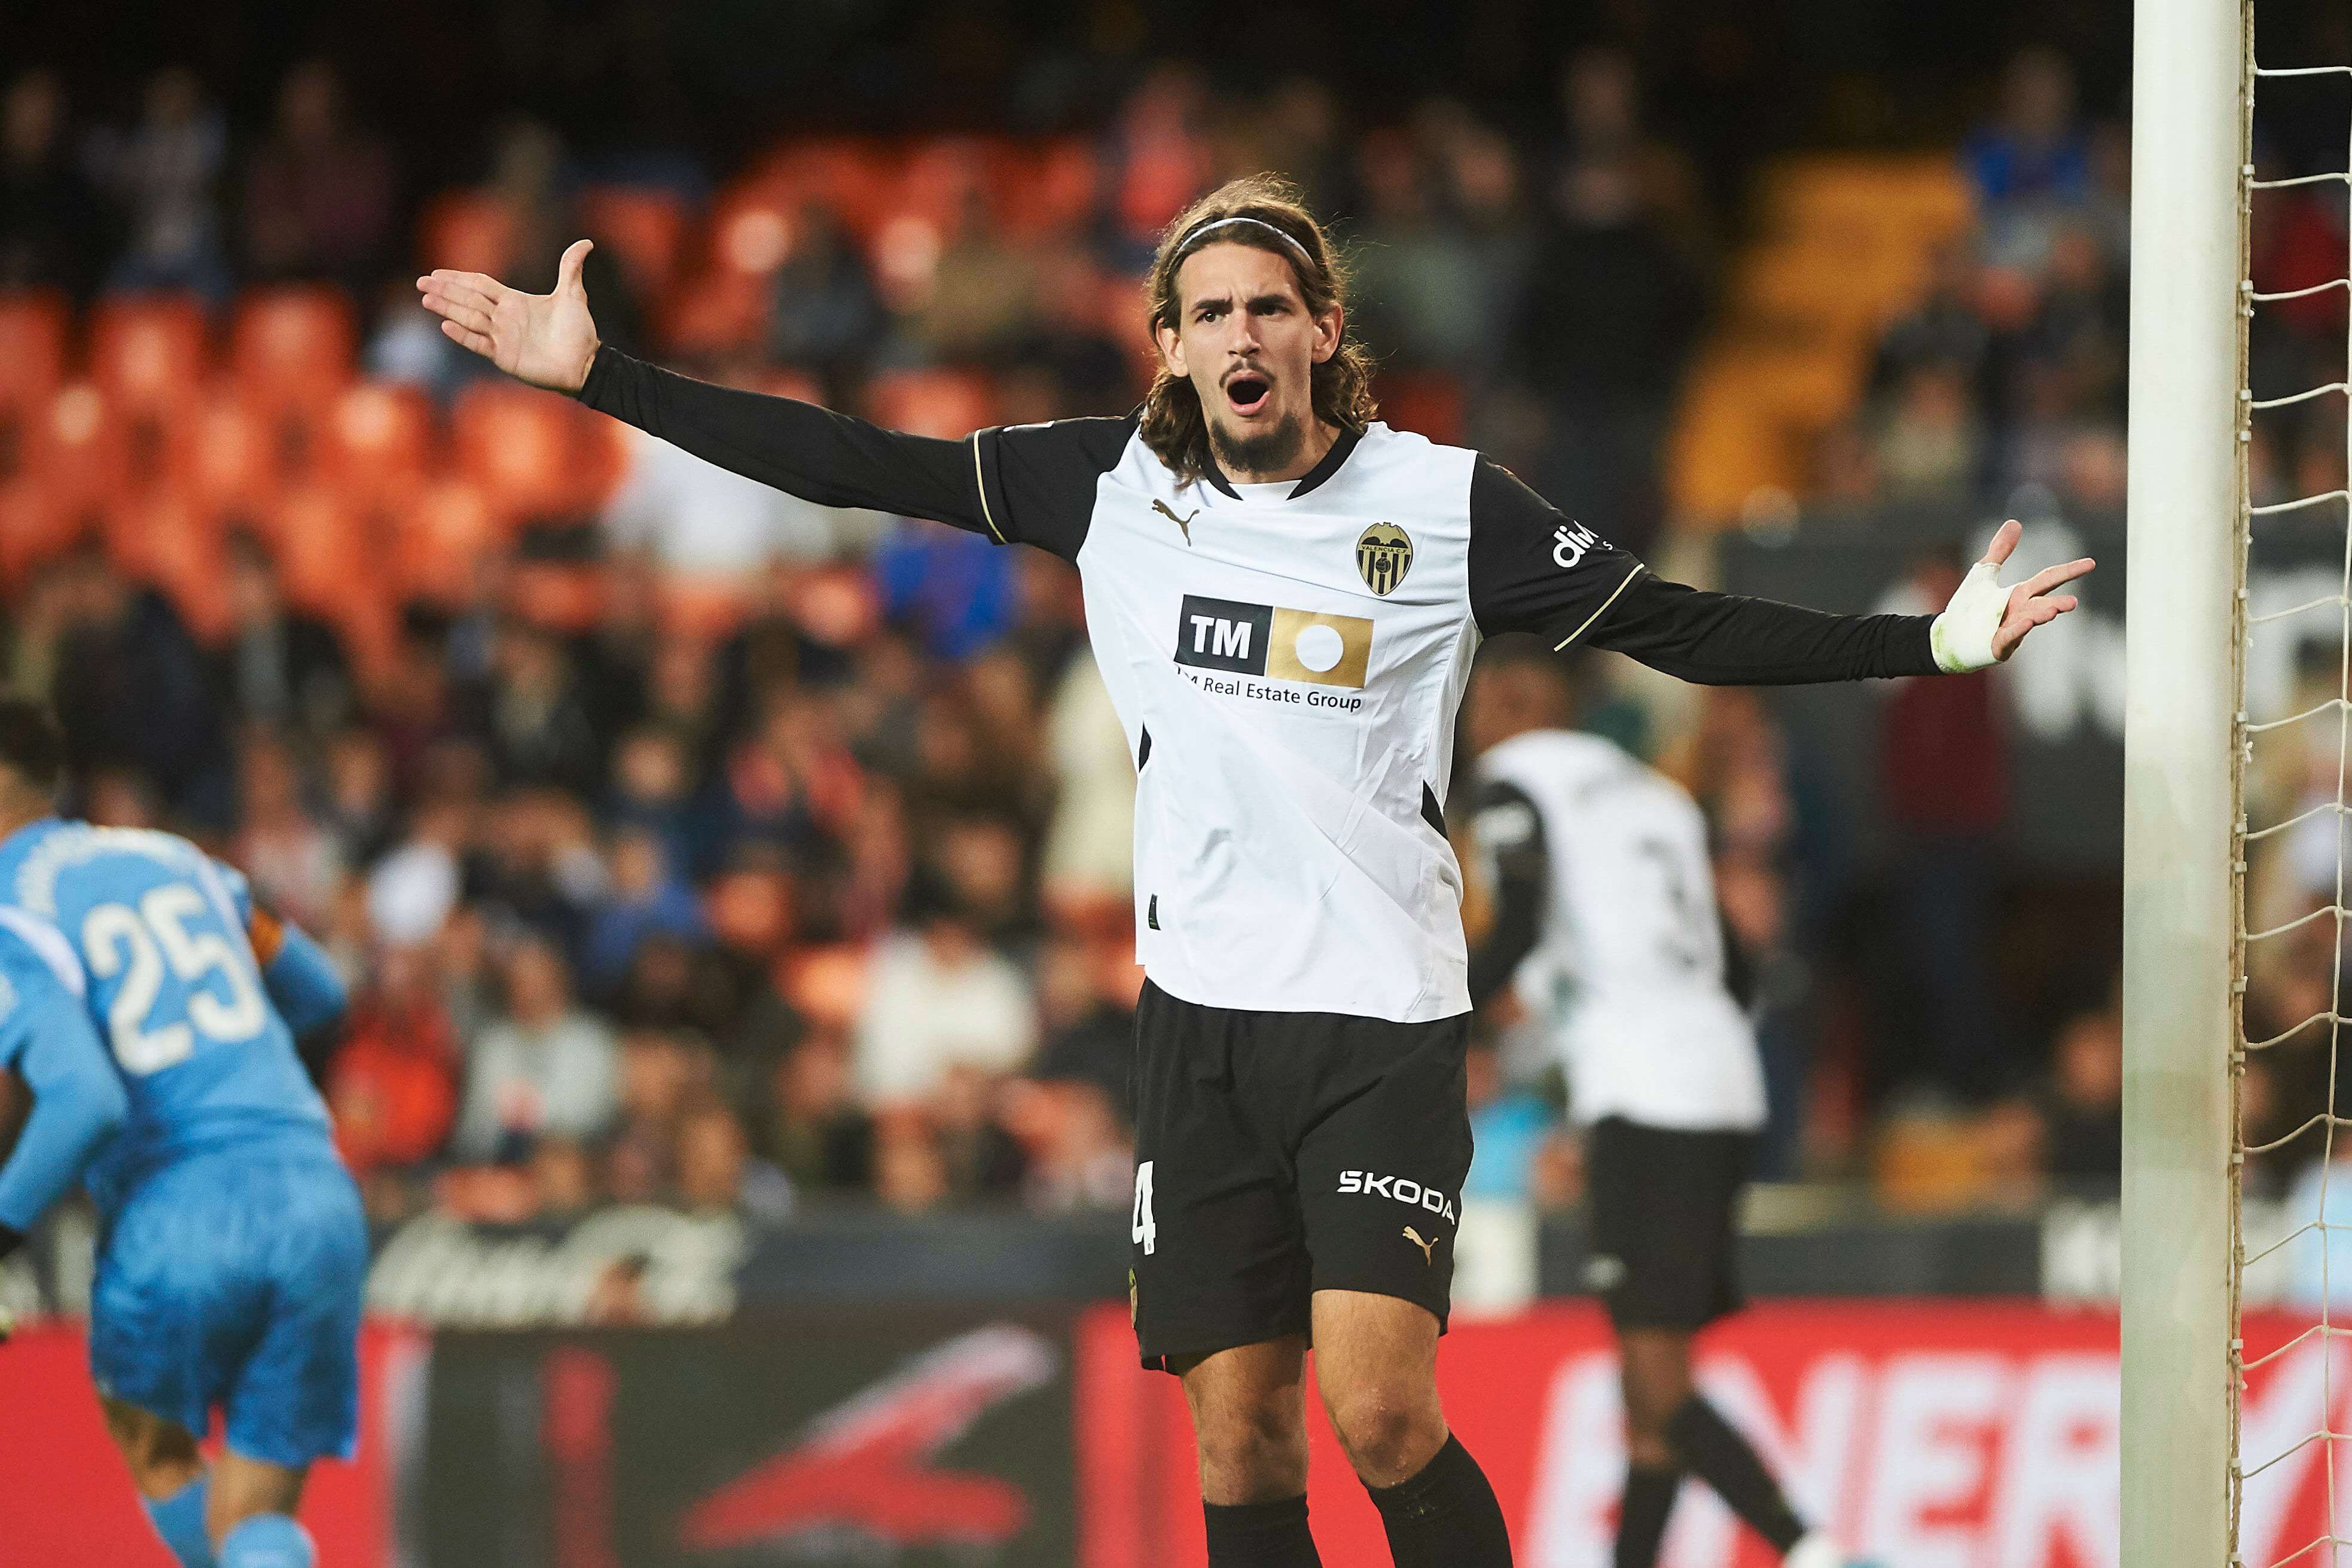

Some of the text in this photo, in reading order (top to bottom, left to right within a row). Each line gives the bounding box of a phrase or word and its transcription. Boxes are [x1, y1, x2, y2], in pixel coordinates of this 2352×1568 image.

[1190, 615, 1253, 660] TM
[1203, 677, 1362, 713] Real Estate Group
[83, 883, 265, 1075] 25
